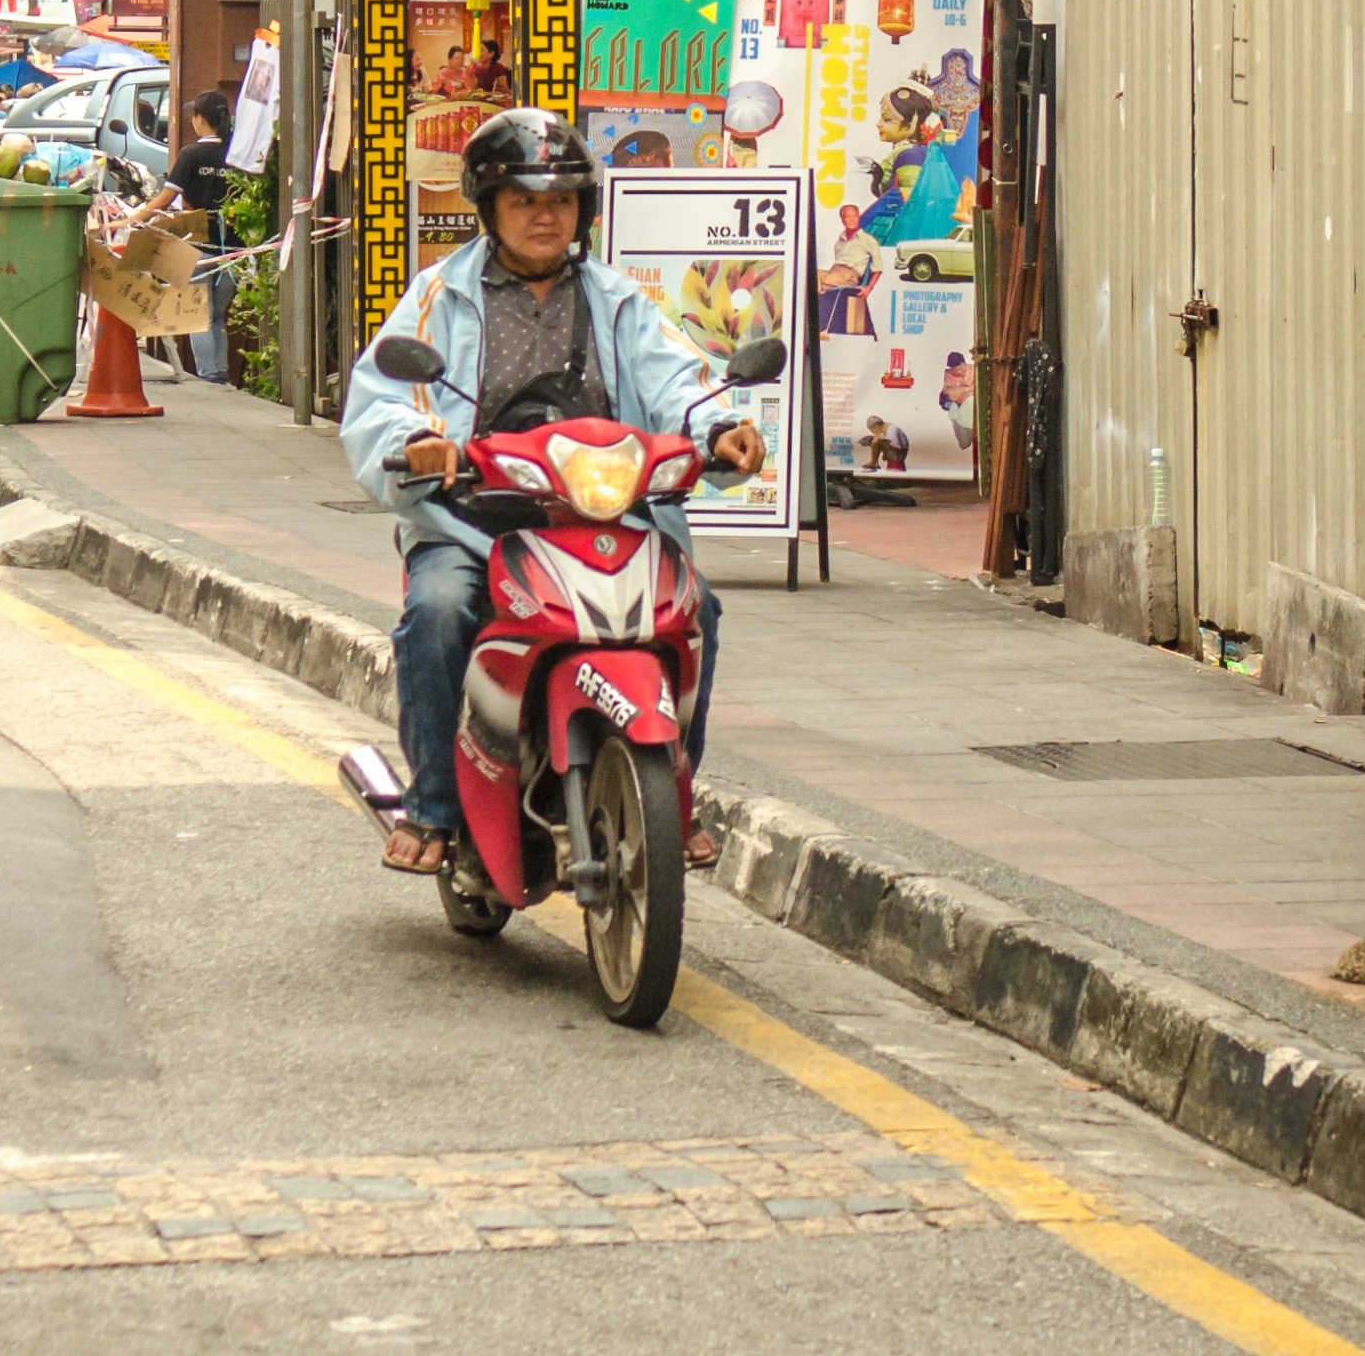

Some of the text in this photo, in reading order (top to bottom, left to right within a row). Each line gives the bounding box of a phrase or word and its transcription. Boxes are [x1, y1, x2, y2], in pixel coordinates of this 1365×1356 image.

[741, 18, 762, 35] NO.
[944, 13, 967, 26] 10-6
[739, 37, 759, 60] 13
[851, 24, 870, 123] STUDIO
[816, 23, 852, 210] HOWARD
[707, 198, 786, 238] NO. 13
[903, 290, 963, 303] PHOTOGRAPHY
[903, 302, 947, 313] GALLERY &
[902, 313, 927, 323] LOCAL
[902, 324, 924, 335] SHOP
